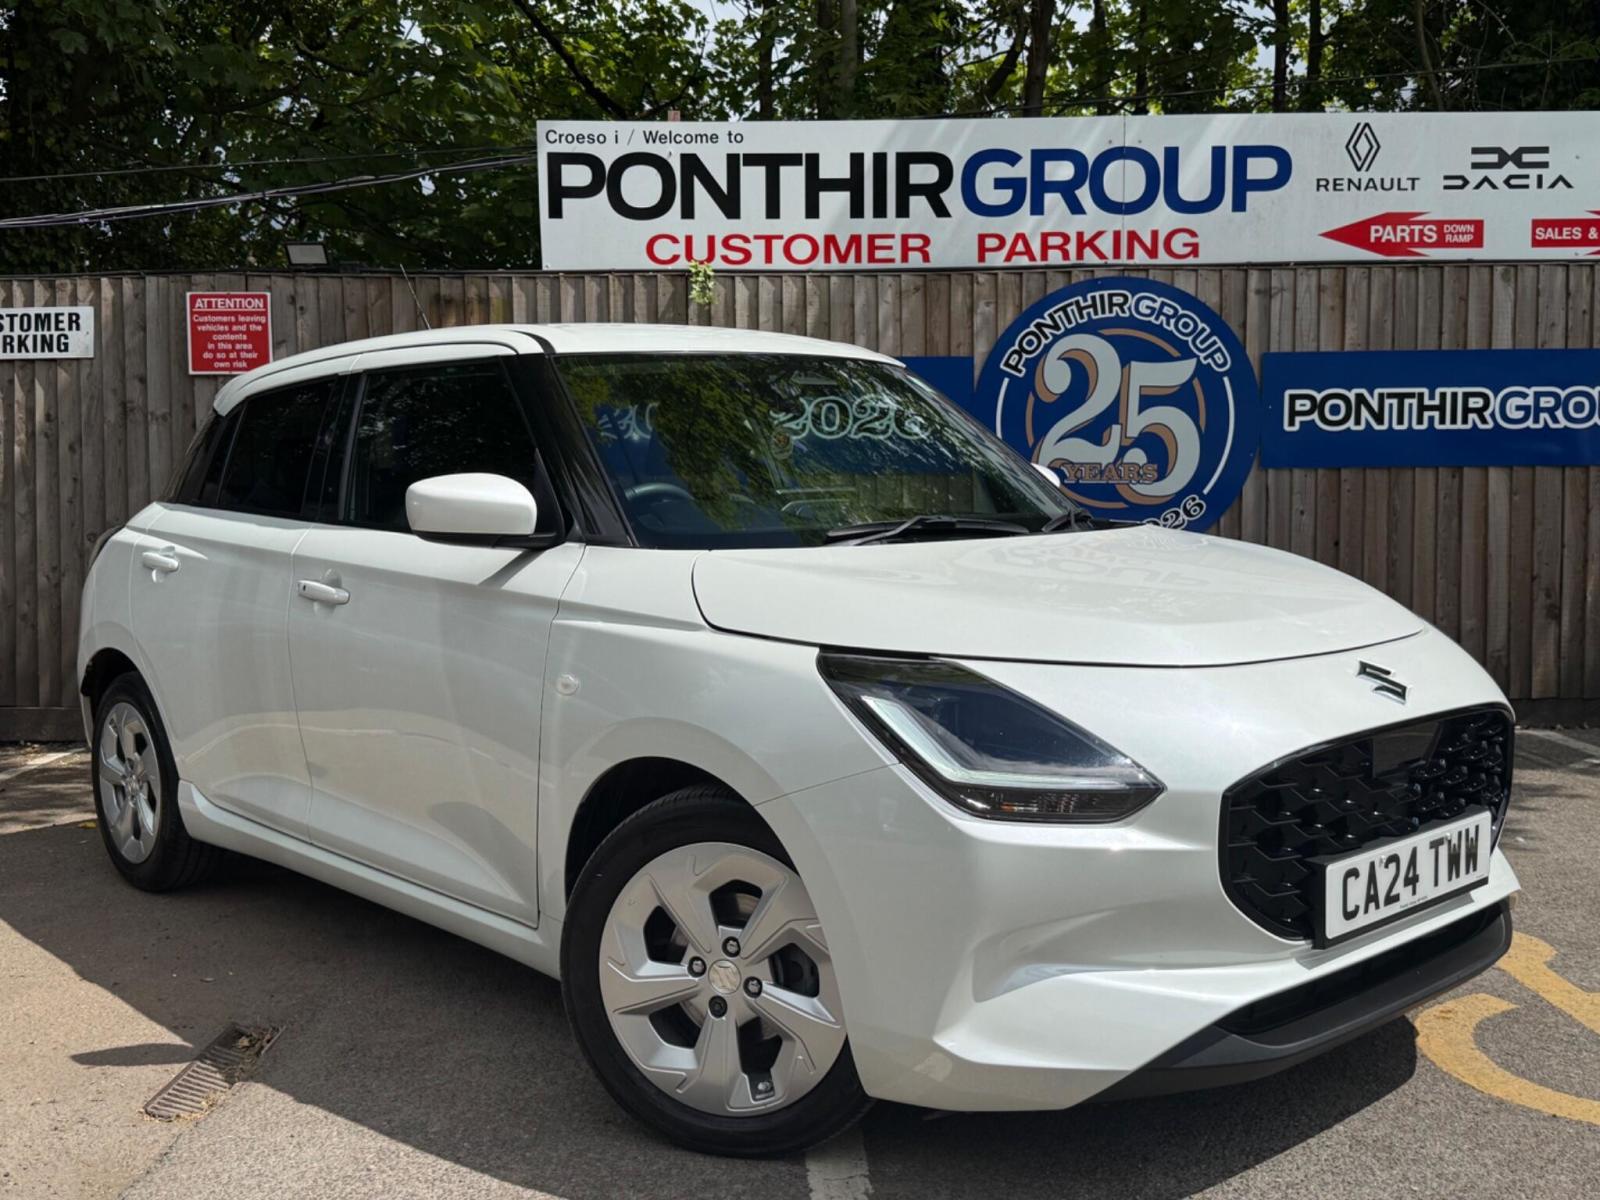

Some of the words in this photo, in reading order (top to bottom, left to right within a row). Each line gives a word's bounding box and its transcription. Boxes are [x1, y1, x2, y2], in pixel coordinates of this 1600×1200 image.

[545, 129, 606, 145] Croeso
[614, 130, 619, 144] i
[643, 130, 719, 145] Welcome
[728, 130, 744, 144] to
[1316, 177, 1420, 192] RENAULT
[1443, 174, 1574, 190] DACIA
[1370, 225, 1437, 243] PARTS
[1443, 224, 1475, 233] DOWN
[1535, 227, 1582, 240] SALES
[1588, 227, 1598, 239] &
[646, 233, 931, 265] CUSTOMER
[977, 228, 1200, 263] PARKING
[1445, 234, 1474, 243] RAMP
[195, 298, 264, 309] ATTENTION
[193, 314, 235, 322] Customers
[238, 314, 266, 324] leaving
[2, 334, 69, 353] RKING
[1035, 333, 1200, 503] 25
[1061, 463, 1159, 485] YEARS
[1342, 846, 1420, 921] CA24
[1429, 825, 1479, 888] TWW
